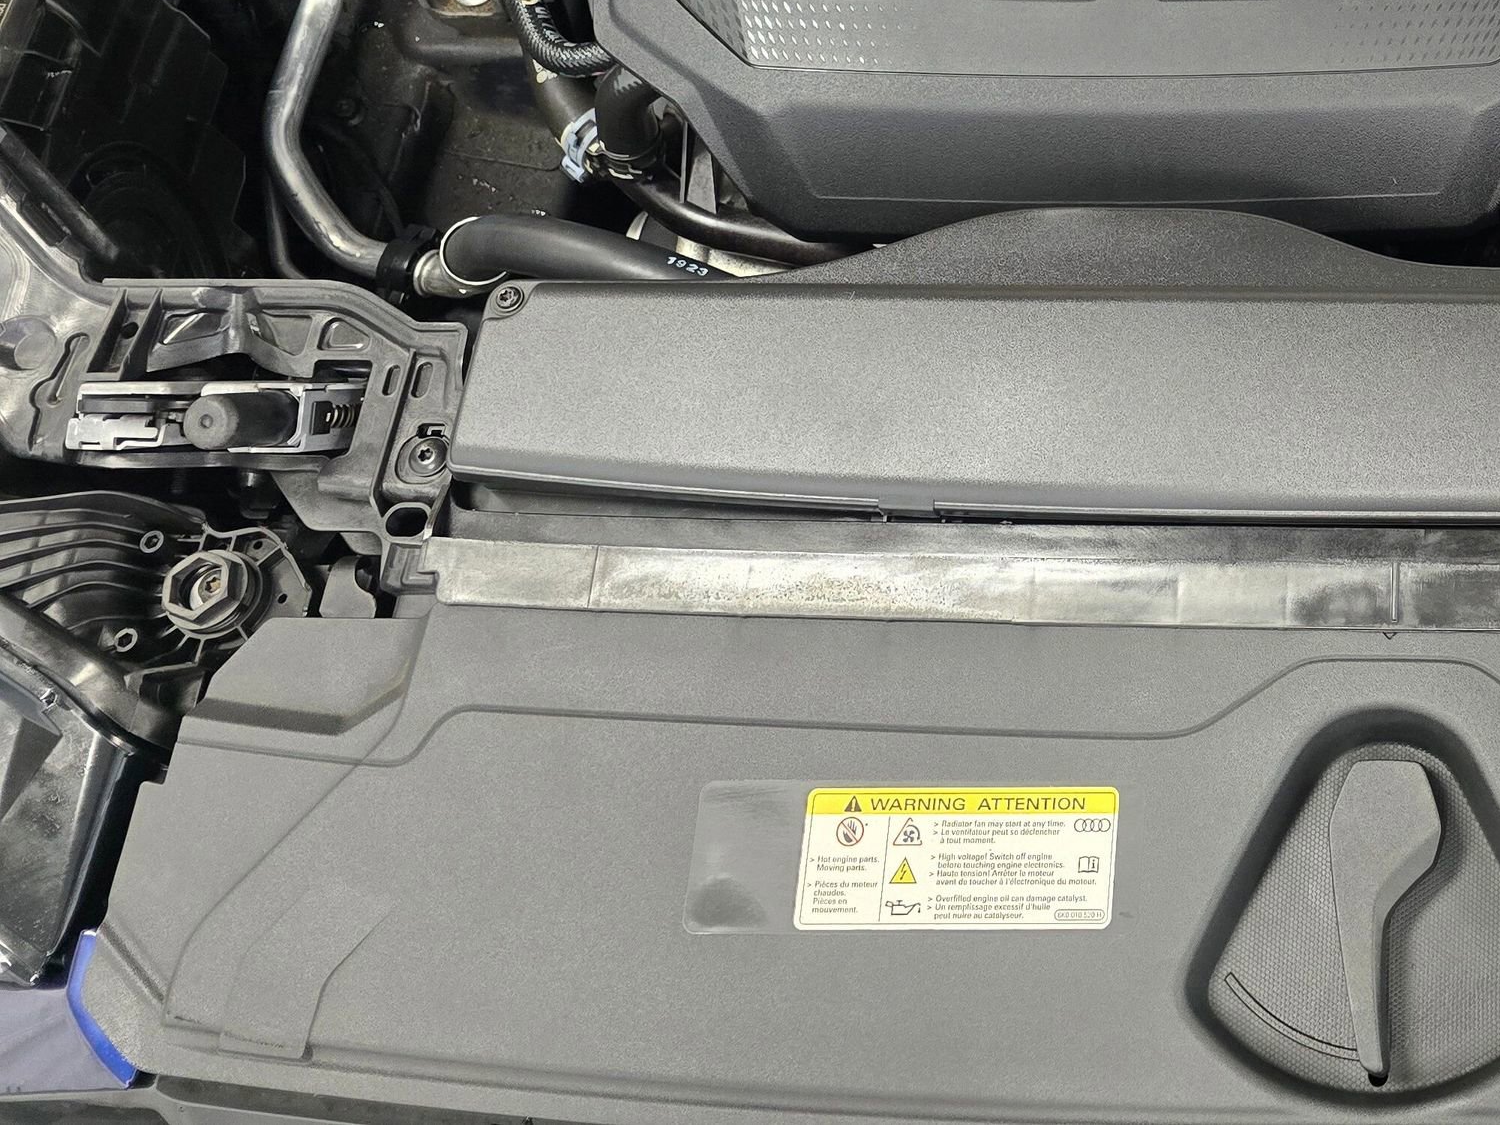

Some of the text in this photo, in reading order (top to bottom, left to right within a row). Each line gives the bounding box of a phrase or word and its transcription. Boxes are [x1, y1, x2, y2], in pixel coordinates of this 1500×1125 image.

[666, 256, 709, 276] 1923
[870, 797, 1087, 812] WARNING ATTENTION
[987, 821, 1004, 829] may
[1032, 821, 1046, 829] any
[951, 828, 991, 836] ventilateur
[992, 830, 1009, 838] peut
[1020, 828, 1060, 836] déclencher
[939, 836, 945, 844] à
[832, 856, 858, 864] engine
[859, 856, 880, 865] parts.
[938, 853, 1053, 863] High voltage! Switch off engine
[816, 864, 867, 873] Moving parts.
[937, 861, 1065, 870] before touching engine electronics.
[992, 869, 1018, 877] Arrêter
[814, 880, 838, 888] Pièces
[1068, 878, 1097, 886] moteur.
[812, 897, 836, 905] Pièces
[973, 895, 999, 904] engine
[1025, 895, 1056, 904] damage
[1057, 895, 1088, 904] catalyst.
[947, 903, 993, 912] remplissage
[1025, 903, 1051, 911] d'huile
[934, 912, 951, 920] peut
[984, 912, 1024, 920] catalyseur.
